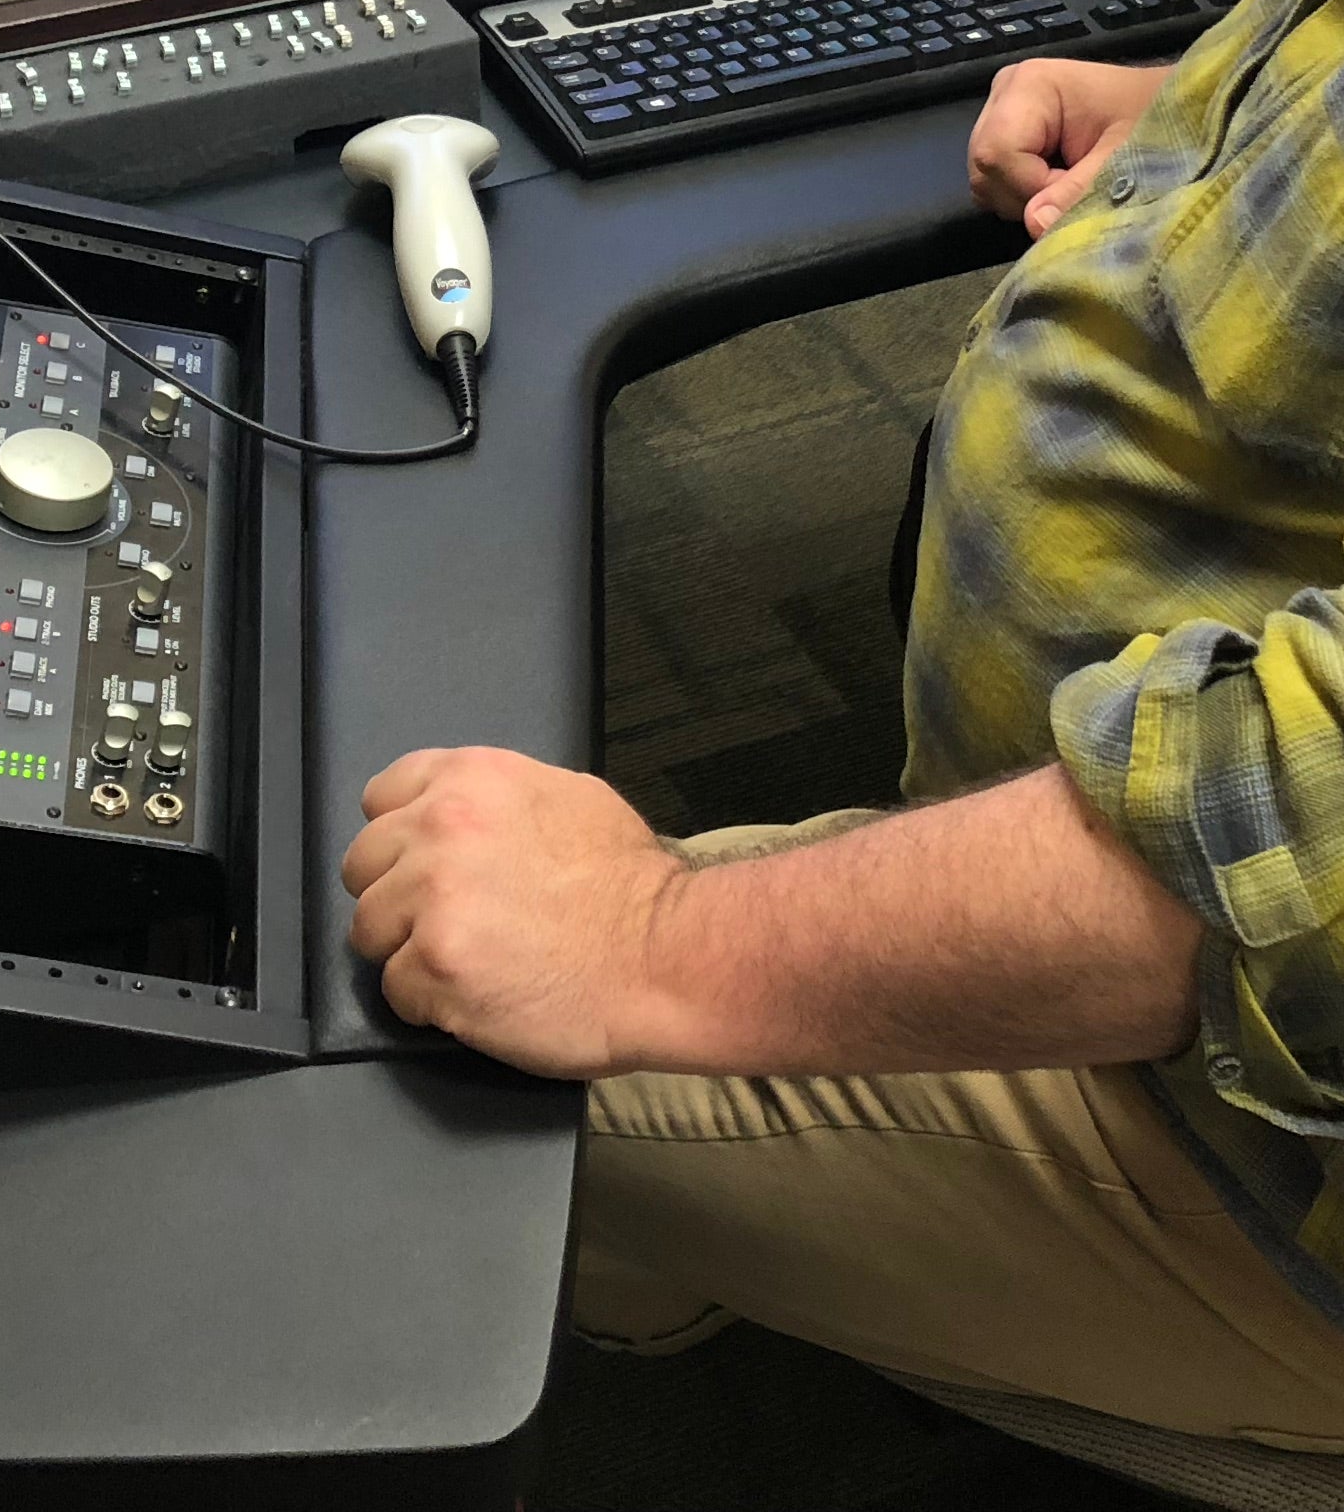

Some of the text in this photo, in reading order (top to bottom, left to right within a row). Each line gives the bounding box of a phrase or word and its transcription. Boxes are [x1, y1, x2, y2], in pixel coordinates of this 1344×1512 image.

[14, 342, 31, 398] MONITOR SELECT
[45, 586, 56, 608] PHONO
[88, 595, 102, 642] STUDIO OUTS
[37, 656, 49, 683] 2-TRACK
[74, 757, 88, 790] PHONES
